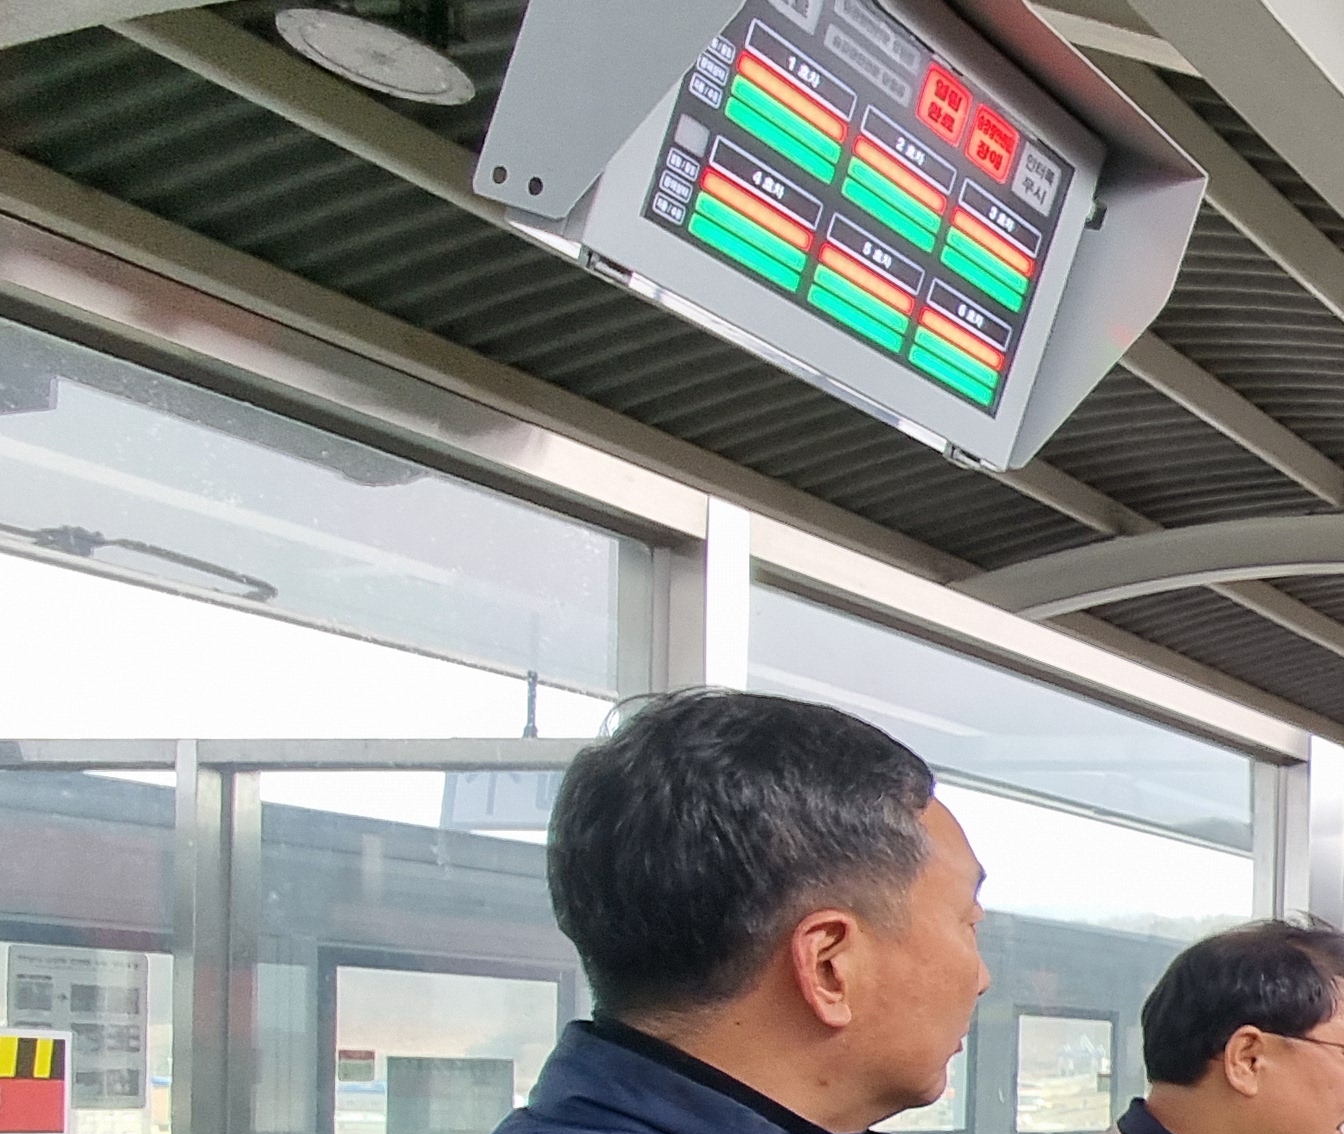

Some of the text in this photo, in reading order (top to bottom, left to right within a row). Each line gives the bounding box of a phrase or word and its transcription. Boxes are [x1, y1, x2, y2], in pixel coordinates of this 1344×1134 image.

[787, 56, 796, 71] 1
[934, 77, 963, 111] 열림
[928, 101, 955, 133] 완료
[896, 136, 904, 152] 2
[975, 140, 1004, 172] 장애
[752, 171, 762, 186] 4
